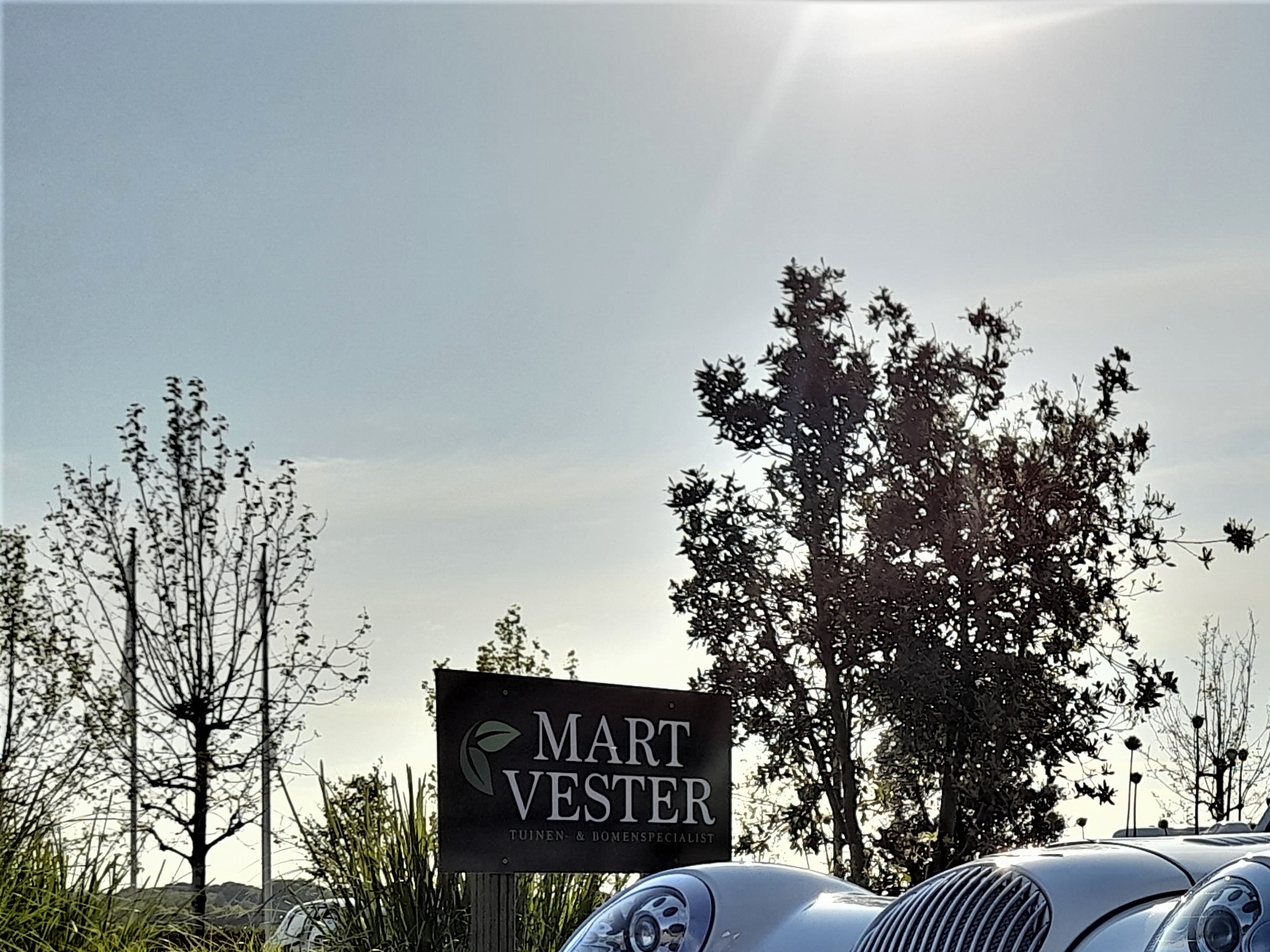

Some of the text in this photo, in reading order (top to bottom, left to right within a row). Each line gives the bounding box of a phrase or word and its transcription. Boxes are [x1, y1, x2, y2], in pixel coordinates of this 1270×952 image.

[533, 711, 690, 767] MART
[503, 770, 716, 825] VESTER
[509, 829, 715, 844] TUINEN- & BOMENSPECIALIST
